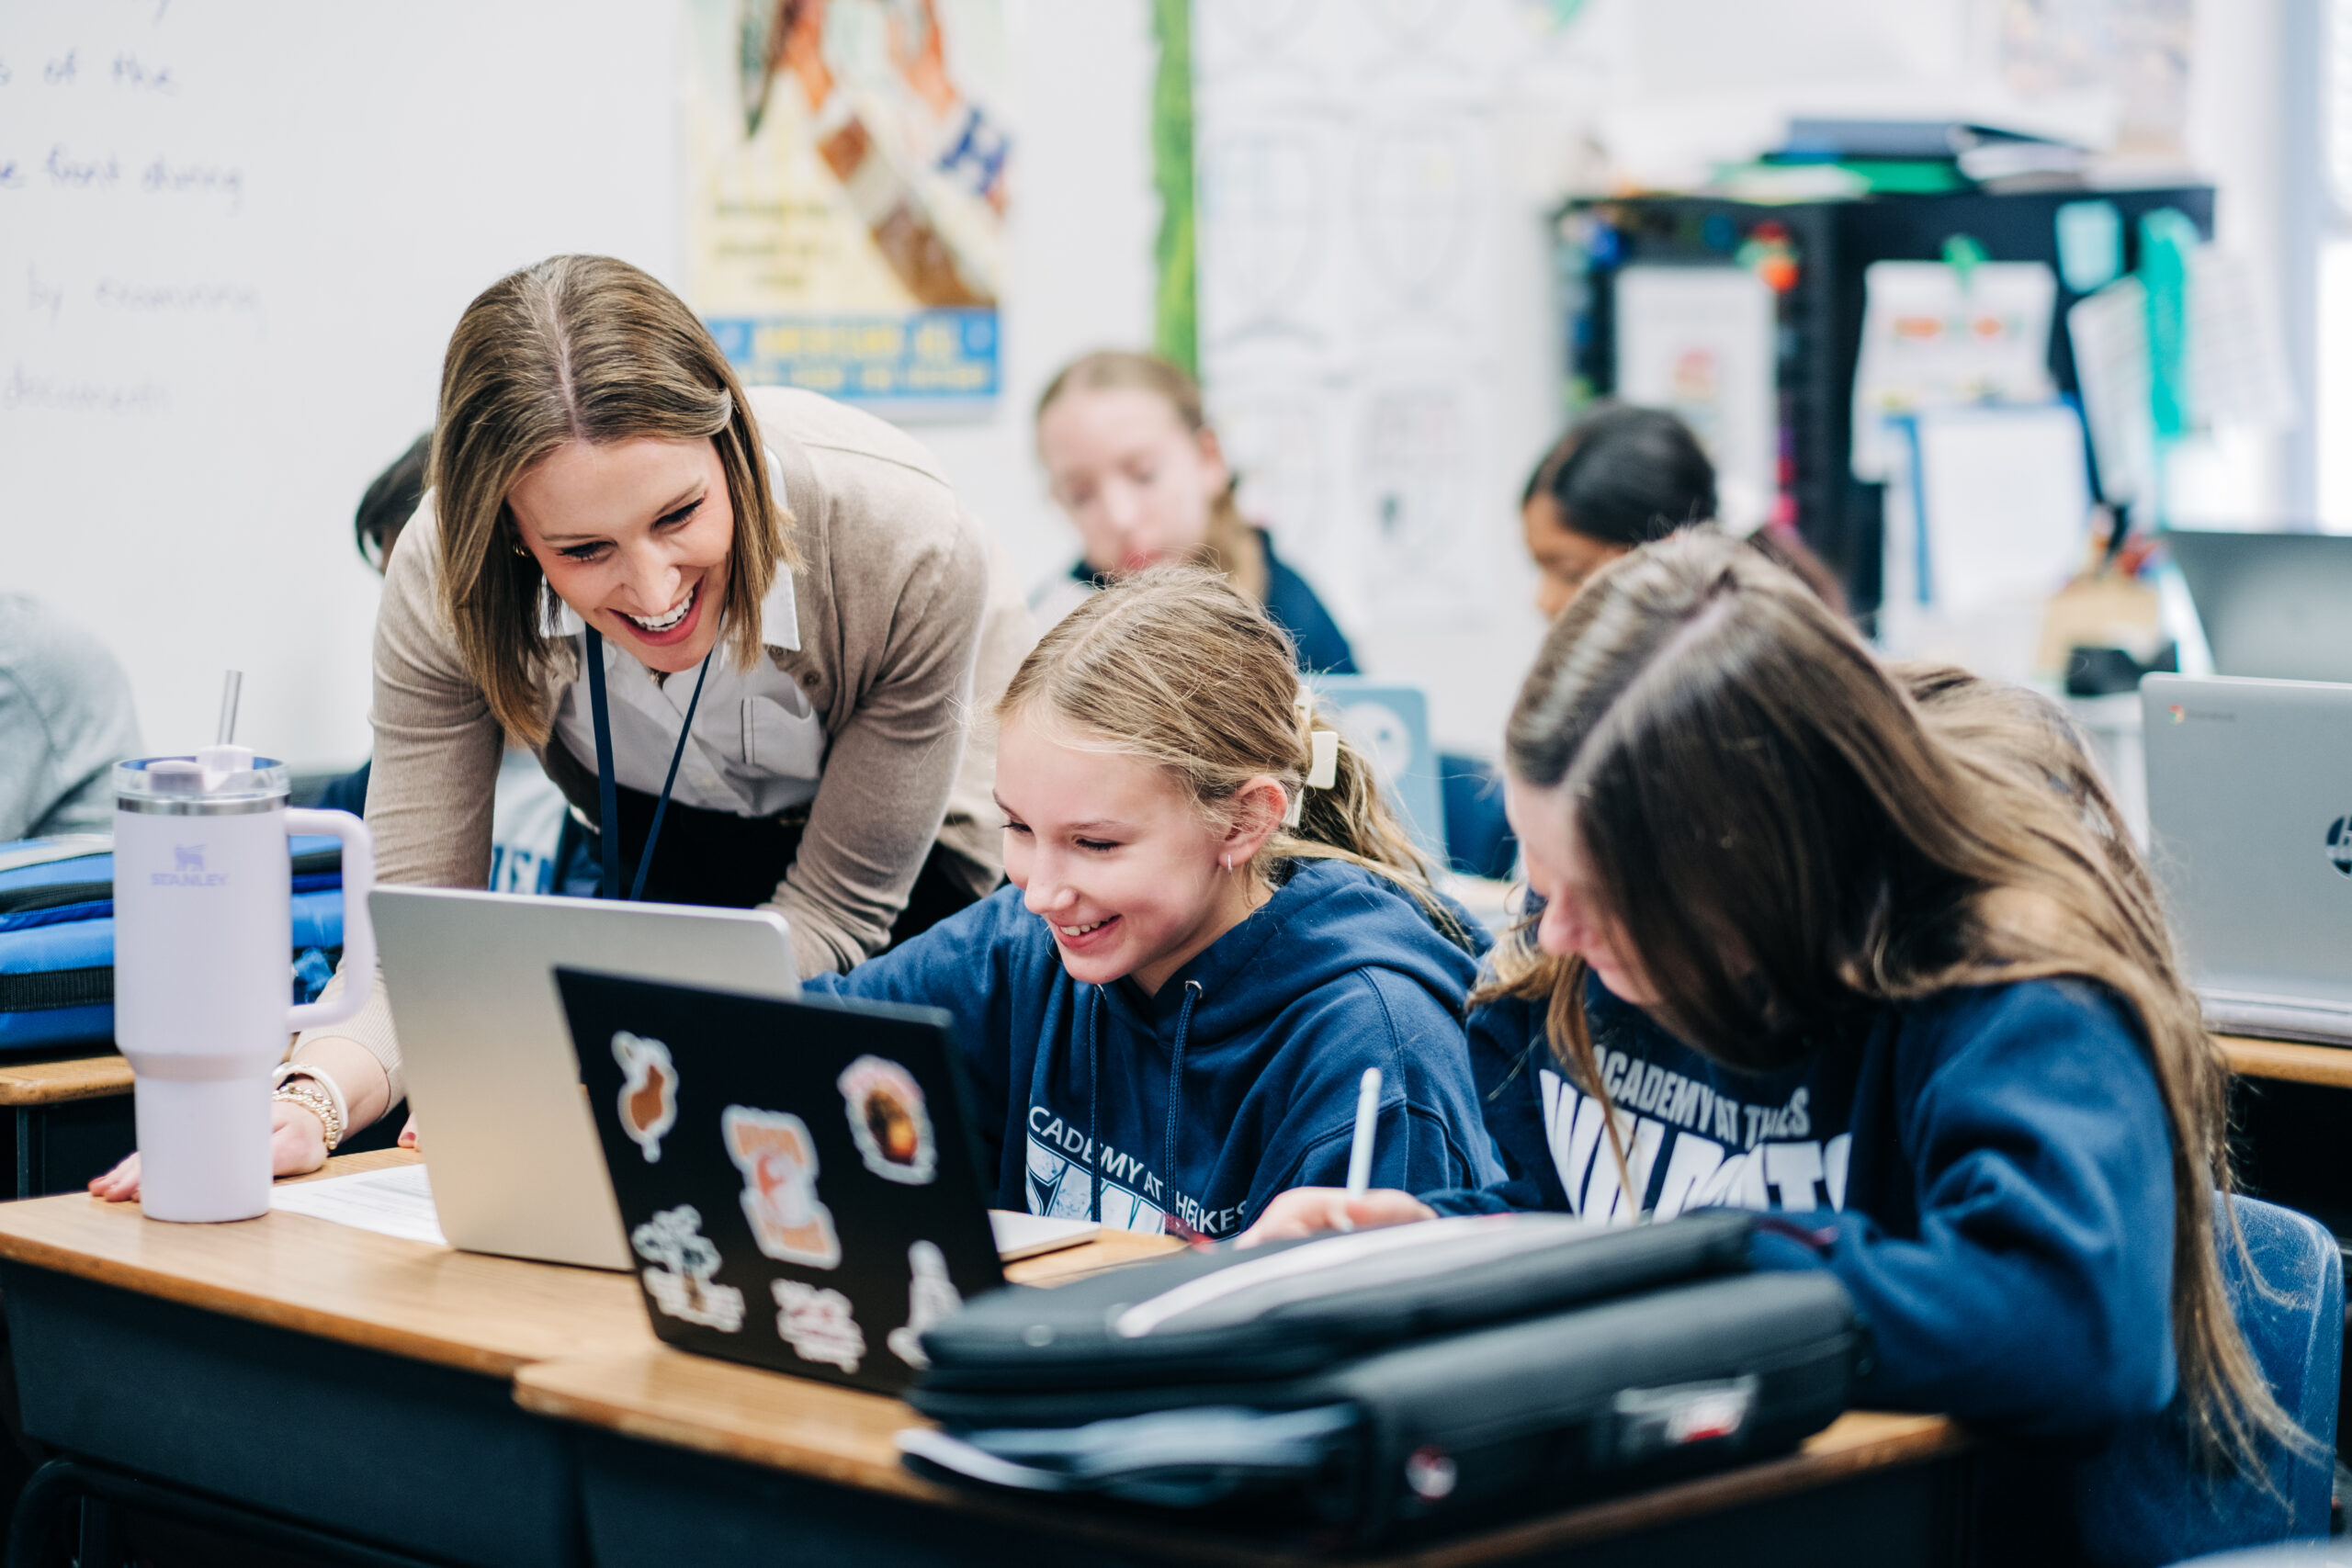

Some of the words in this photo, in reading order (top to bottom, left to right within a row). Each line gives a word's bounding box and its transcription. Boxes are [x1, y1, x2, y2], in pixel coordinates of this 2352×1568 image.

[109, 50, 180, 96] the
[140, 152, 246, 218] during
[27, 258, 64, 329] by
[151, 873, 229, 887] STANLEY
[1714, 1094, 1739, 1146] AT
[1028, 1105, 1145, 1184] CADEMY
[1143, 1170, 1164, 1201] AT
[1175, 1190, 1199, 1228] HE
